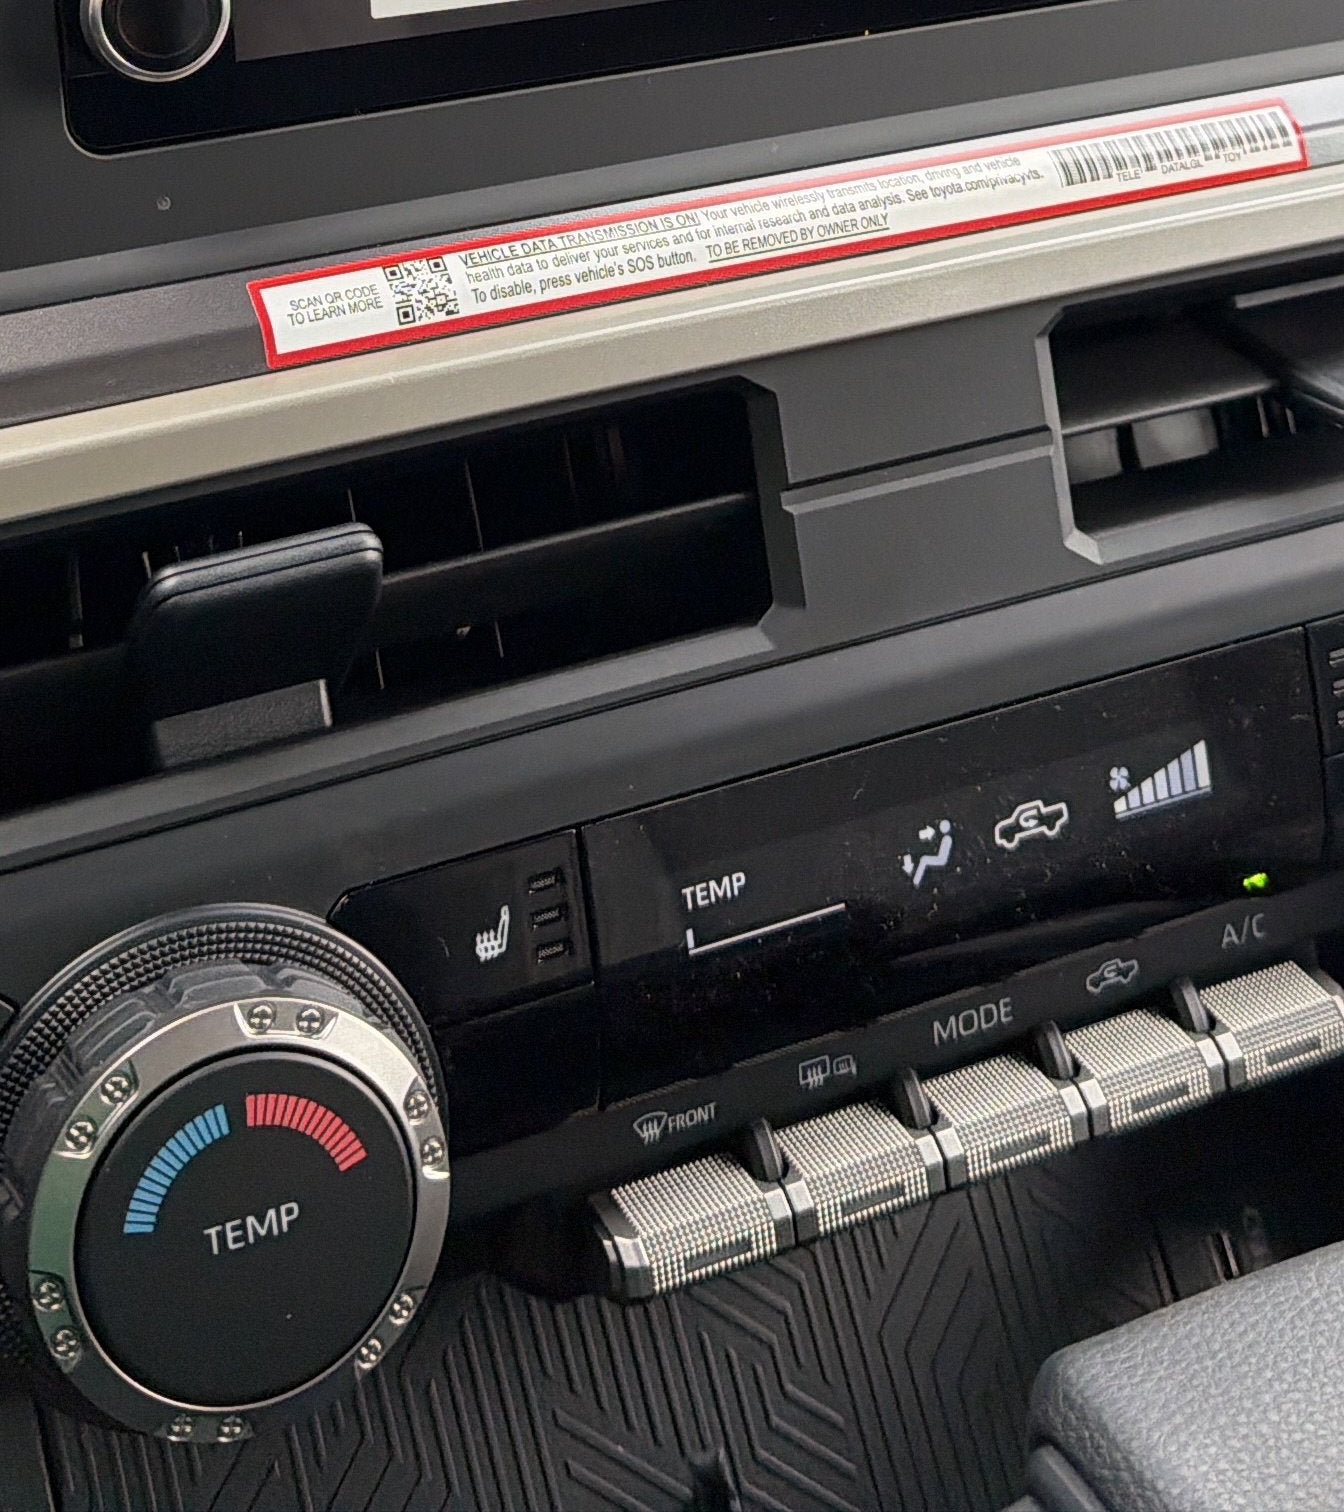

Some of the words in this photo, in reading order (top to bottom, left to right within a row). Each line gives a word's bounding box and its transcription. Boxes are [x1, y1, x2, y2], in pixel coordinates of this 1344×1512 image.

[458, 245, 520, 266] VEHICLE
[521, 239, 556, 255] DATA
[558, 219, 659, 248] TRANSMISSION
[660, 216, 674, 229] IS
[676, 211, 699, 227] ON!
[700, 209, 728, 222] Your
[730, 200, 770, 217] vehicle
[771, 190, 826, 209] wirelessly
[826, 181, 878, 199] transmits
[962, 162, 983, 175] and
[465, 266, 505, 285] health
[507, 261, 534, 276] data
[535, 258, 549, 271] to
[552, 249, 591, 268] deliver
[593, 246, 619, 263] your
[622, 238, 670, 255] services
[673, 231, 695, 245] and
[695, 228, 711, 241] for
[712, 218, 757, 238] internal
[758, 209, 807, 229] research
[808, 206, 830, 221] and
[832, 201, 856, 216] data
[858, 192, 906, 210] analysis.
[906, 188, 929, 202] See
[470, 288, 487, 304] To
[490, 279, 537, 300] disable,
[539, 275, 572, 295] press
[574, 260, 624, 284] vehicle's
[627, 255, 655, 273] SOS
[657, 250, 697, 269] button.
[705, 243, 722, 258] TO
[724, 240, 741, 255] BE
[742, 229, 798, 252] REMOVED
[799, 226, 815, 239] BY
[816, 218, 858, 238] OWNER
[860, 212, 889, 229] ONLY
[287, 312, 305, 326] TO
[306, 305, 346, 323] LEARN
[348, 296, 384, 314] MORE
[289, 296, 323, 311] SCAN
[325, 292, 344, 304] QR
[345, 284, 379, 300] CODE
[681, 872, 747, 914] TEMP
[1220, 912, 1268, 950] A/C
[932, 997, 1015, 1046] MODE
[667, 1101, 717, 1134] FRONT
[203, 1201, 300, 1255] TEMP
